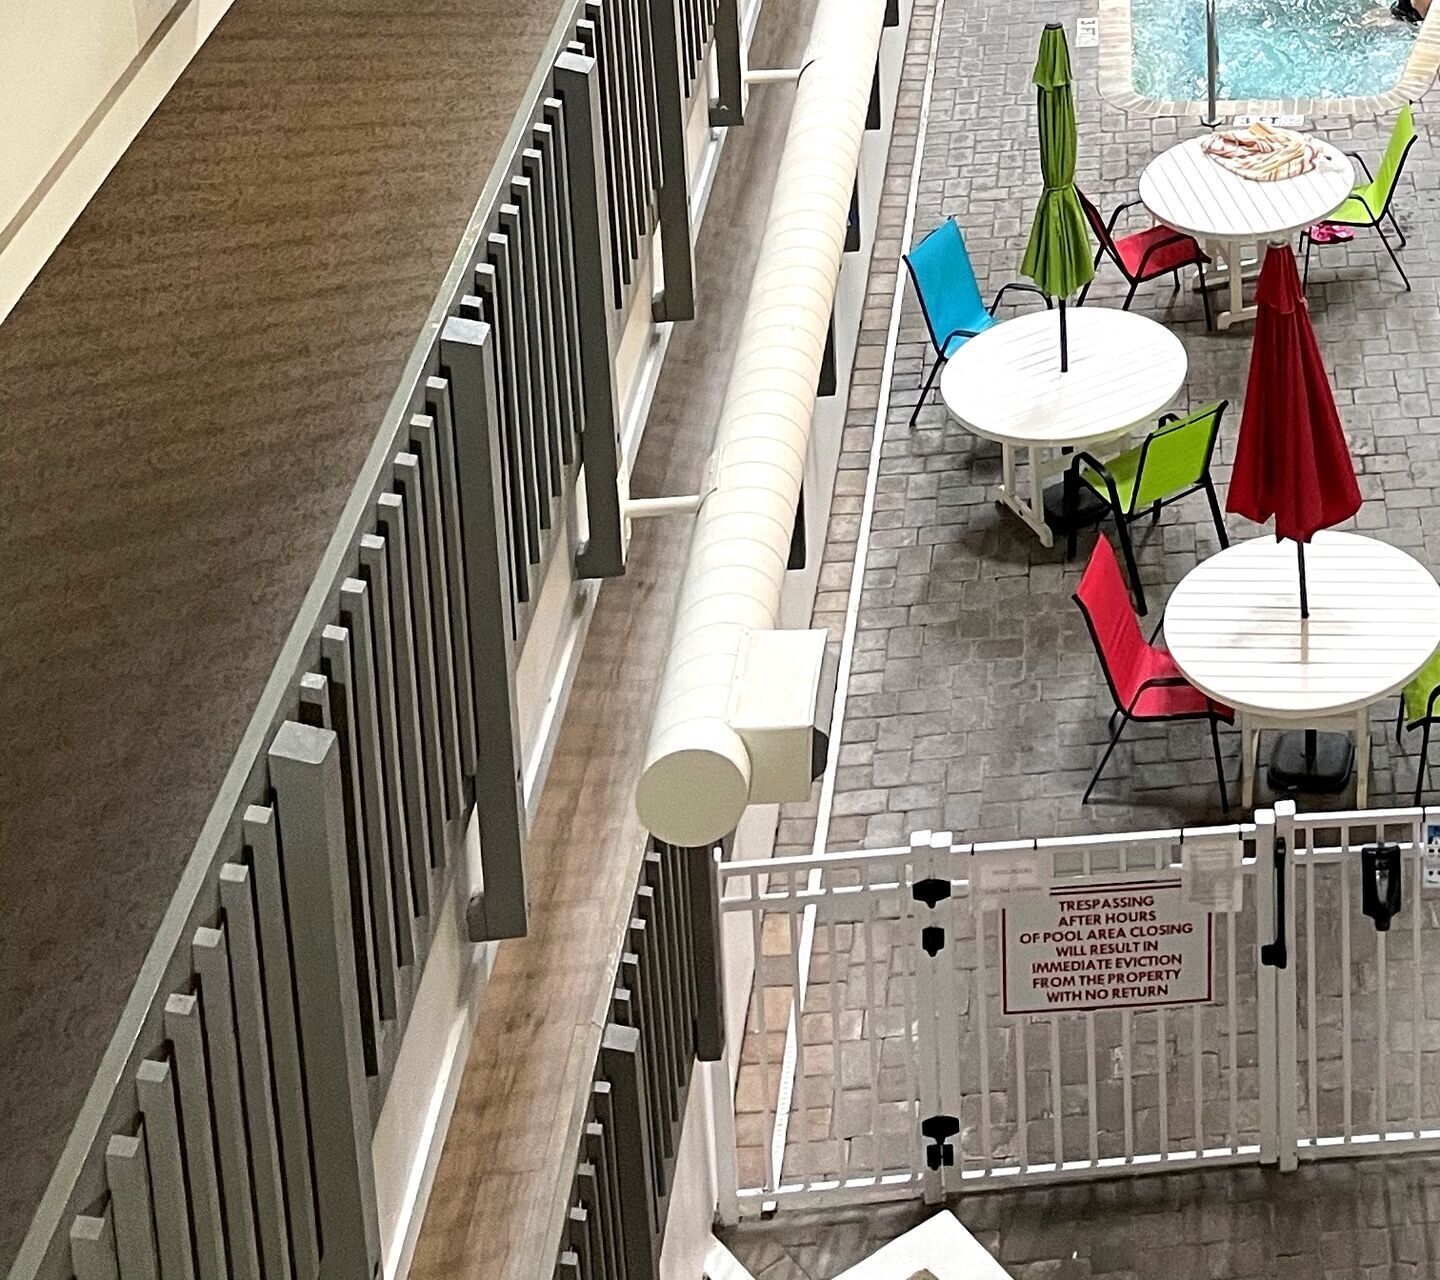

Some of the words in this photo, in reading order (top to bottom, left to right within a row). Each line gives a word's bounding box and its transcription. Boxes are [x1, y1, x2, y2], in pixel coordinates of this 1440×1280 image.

[1058, 895, 1155, 913] TRESPASSING
[1058, 913, 1102, 928] AFTER
[1105, 910, 1157, 925] HOURS
[1019, 932, 1041, 944] OF
[1043, 930, 1084, 944] POOL
[1086, 927, 1127, 941] AREA
[1129, 922, 1194, 938] CLOSING
[1055, 944, 1087, 958] WILL
[1089, 941, 1141, 956] RESULT
[1143, 940, 1159, 952] IN
[1032, 958, 1113, 974] IMMEDIATE
[1115, 953, 1183, 969] EVICTION
[1032, 975, 1076, 989] FROM
[1078, 973, 1105, 987] THE
[1107, 968, 1182, 985] PROPERTY
[1046, 989, 1083, 1003] WITH
[1085, 988, 1109, 1001] NO
[1111, 984, 1169, 1000] RETURN
